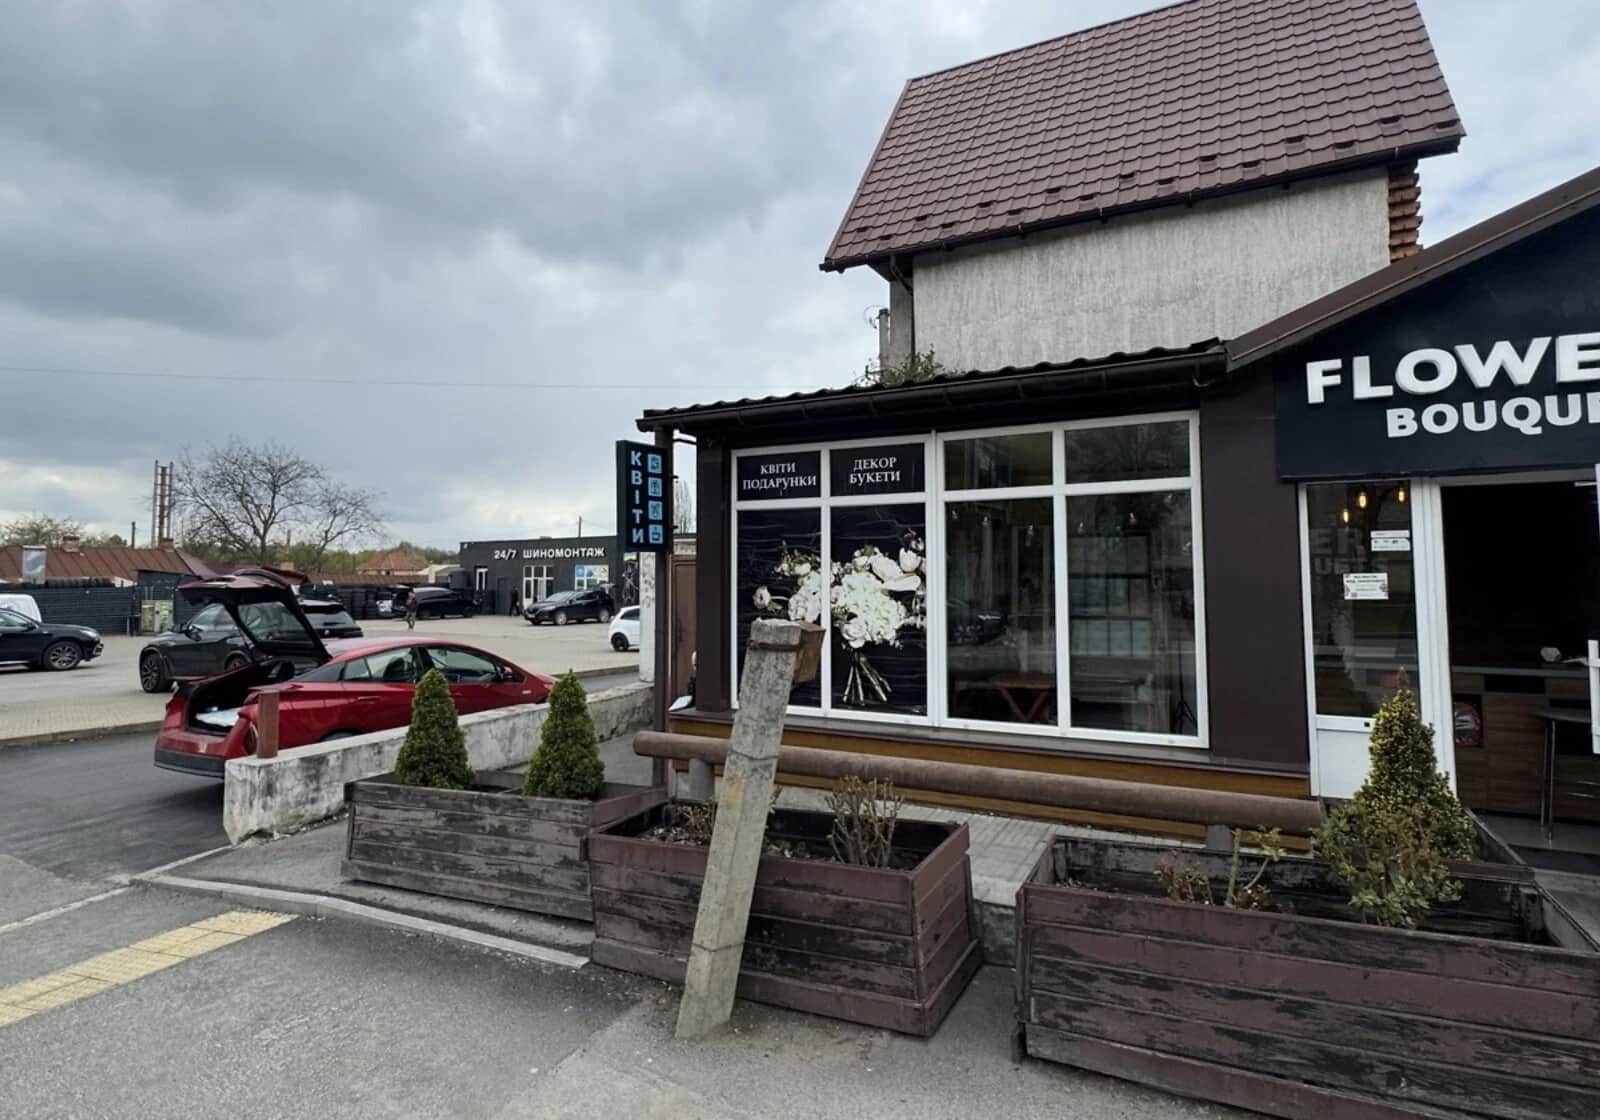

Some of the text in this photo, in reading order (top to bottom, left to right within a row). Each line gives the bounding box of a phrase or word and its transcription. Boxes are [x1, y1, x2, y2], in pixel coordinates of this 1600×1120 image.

[1306, 332, 1600, 404] FLOWE
[760, 463, 796, 475] КВІТИ
[853, 457, 897, 471] ДЕКОР
[743, 476, 817, 490] ПОДАРУНКИ
[850, 471, 901, 486] БУКЕТИ
[630, 450, 644, 544] КВІТИ
[494, 547, 605, 561] 24/7 ШИНОМОНТАЖ
